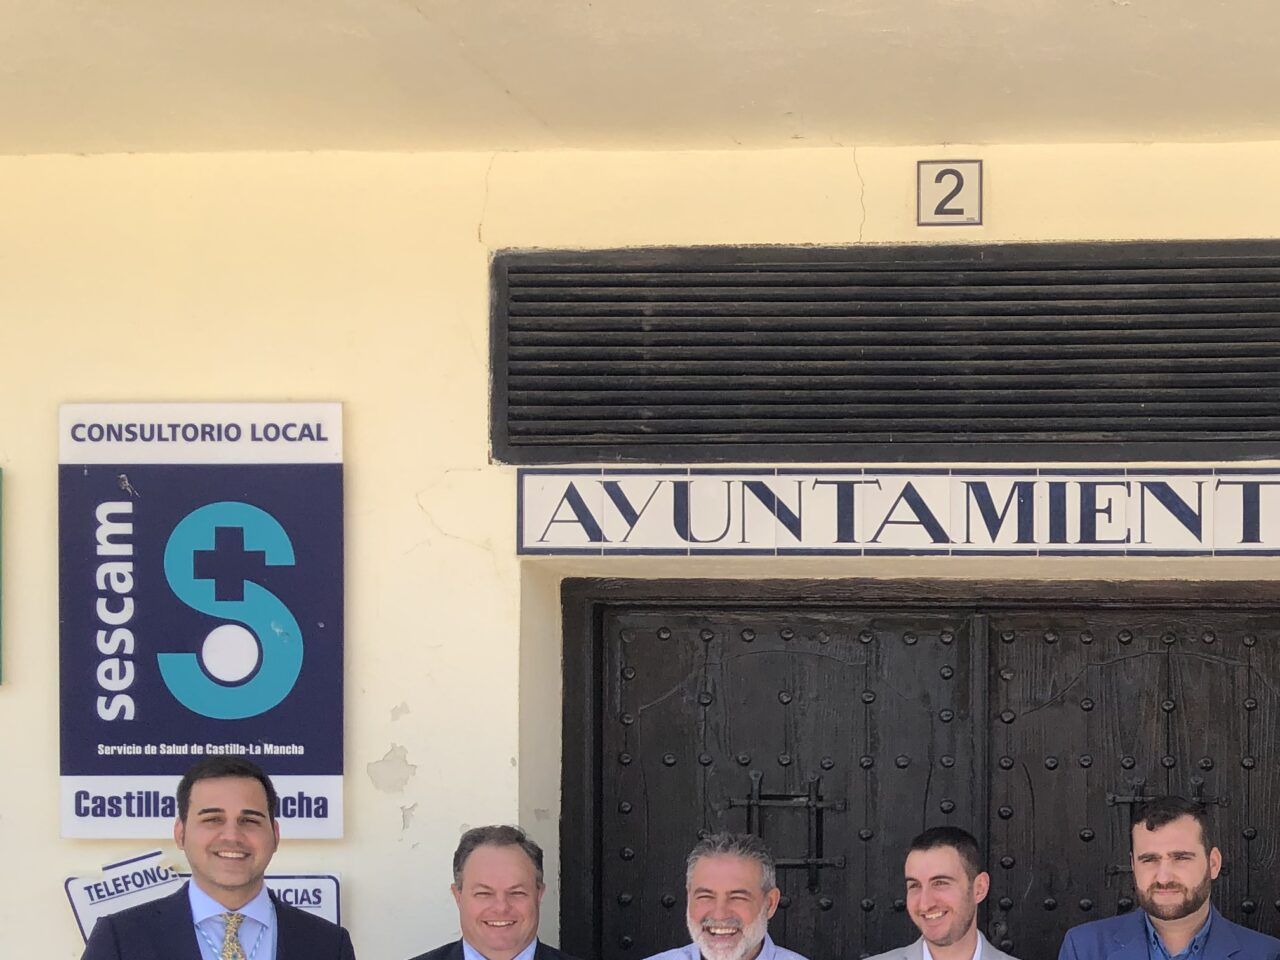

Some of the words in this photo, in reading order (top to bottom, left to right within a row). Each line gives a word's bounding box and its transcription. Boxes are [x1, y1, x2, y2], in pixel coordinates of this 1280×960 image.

[934, 168, 964, 215] 2
[71, 423, 242, 443] CONSULTORIO
[251, 423, 329, 443] LOCAL
[95, 501, 135, 721] sescam
[97, 743, 142, 756] Servicio
[144, 743, 157, 756] de
[159, 743, 188, 756] Salud
[190, 743, 204, 756] de
[205, 743, 261, 756] Castilla-La
[263, 743, 305, 756] Mancha
